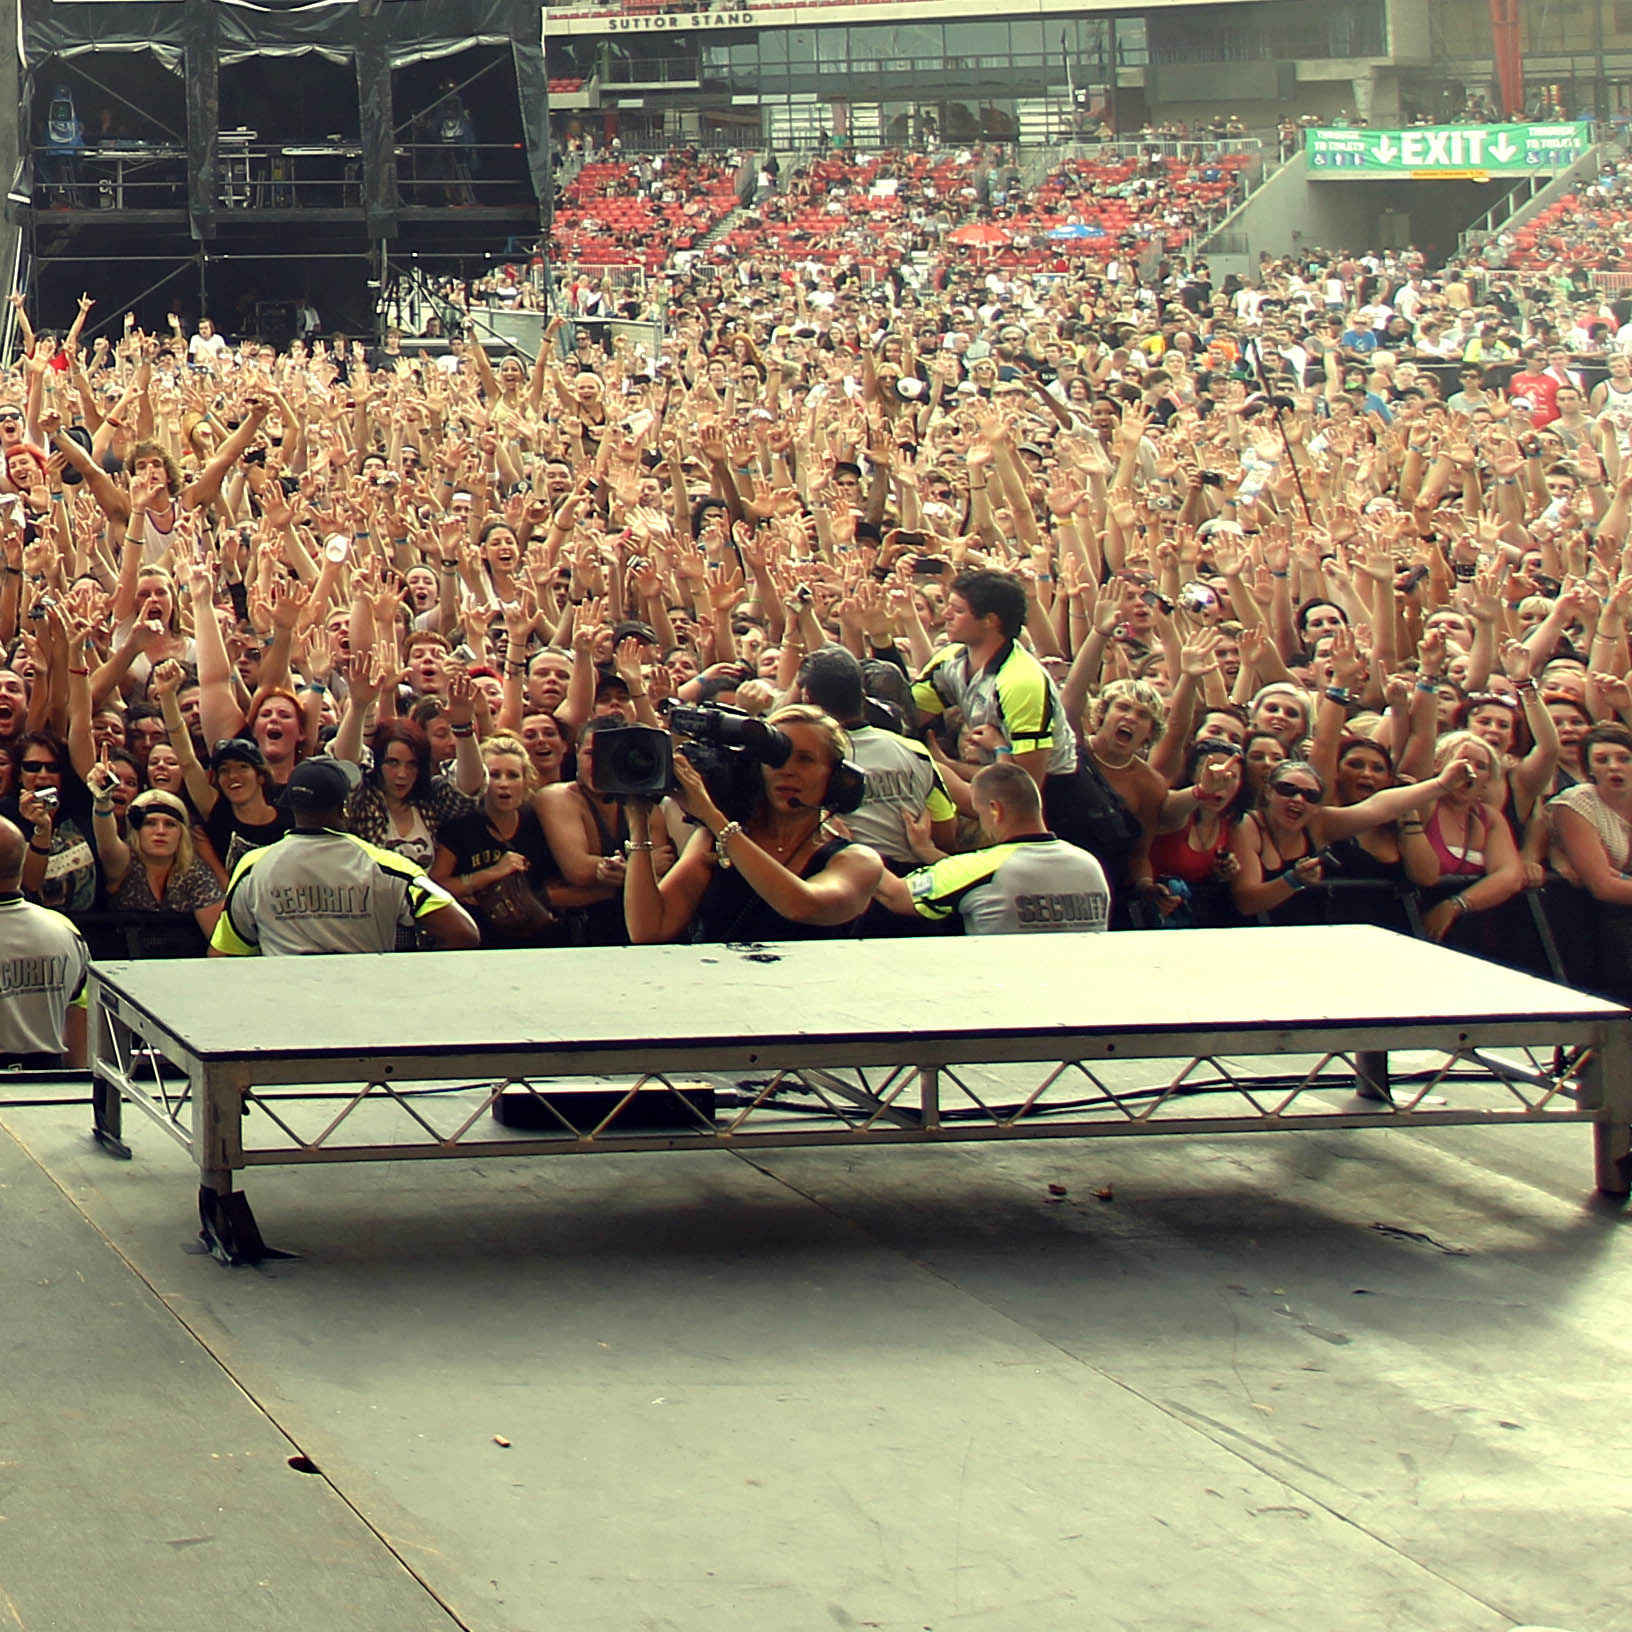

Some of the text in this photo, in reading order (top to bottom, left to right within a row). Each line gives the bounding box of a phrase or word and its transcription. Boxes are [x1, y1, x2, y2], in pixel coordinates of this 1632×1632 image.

[608, 13, 753, 30] SUTTOR STAND
[1401, 130, 1487, 165] EXIT
[270, 885, 370, 915] SECURITY
